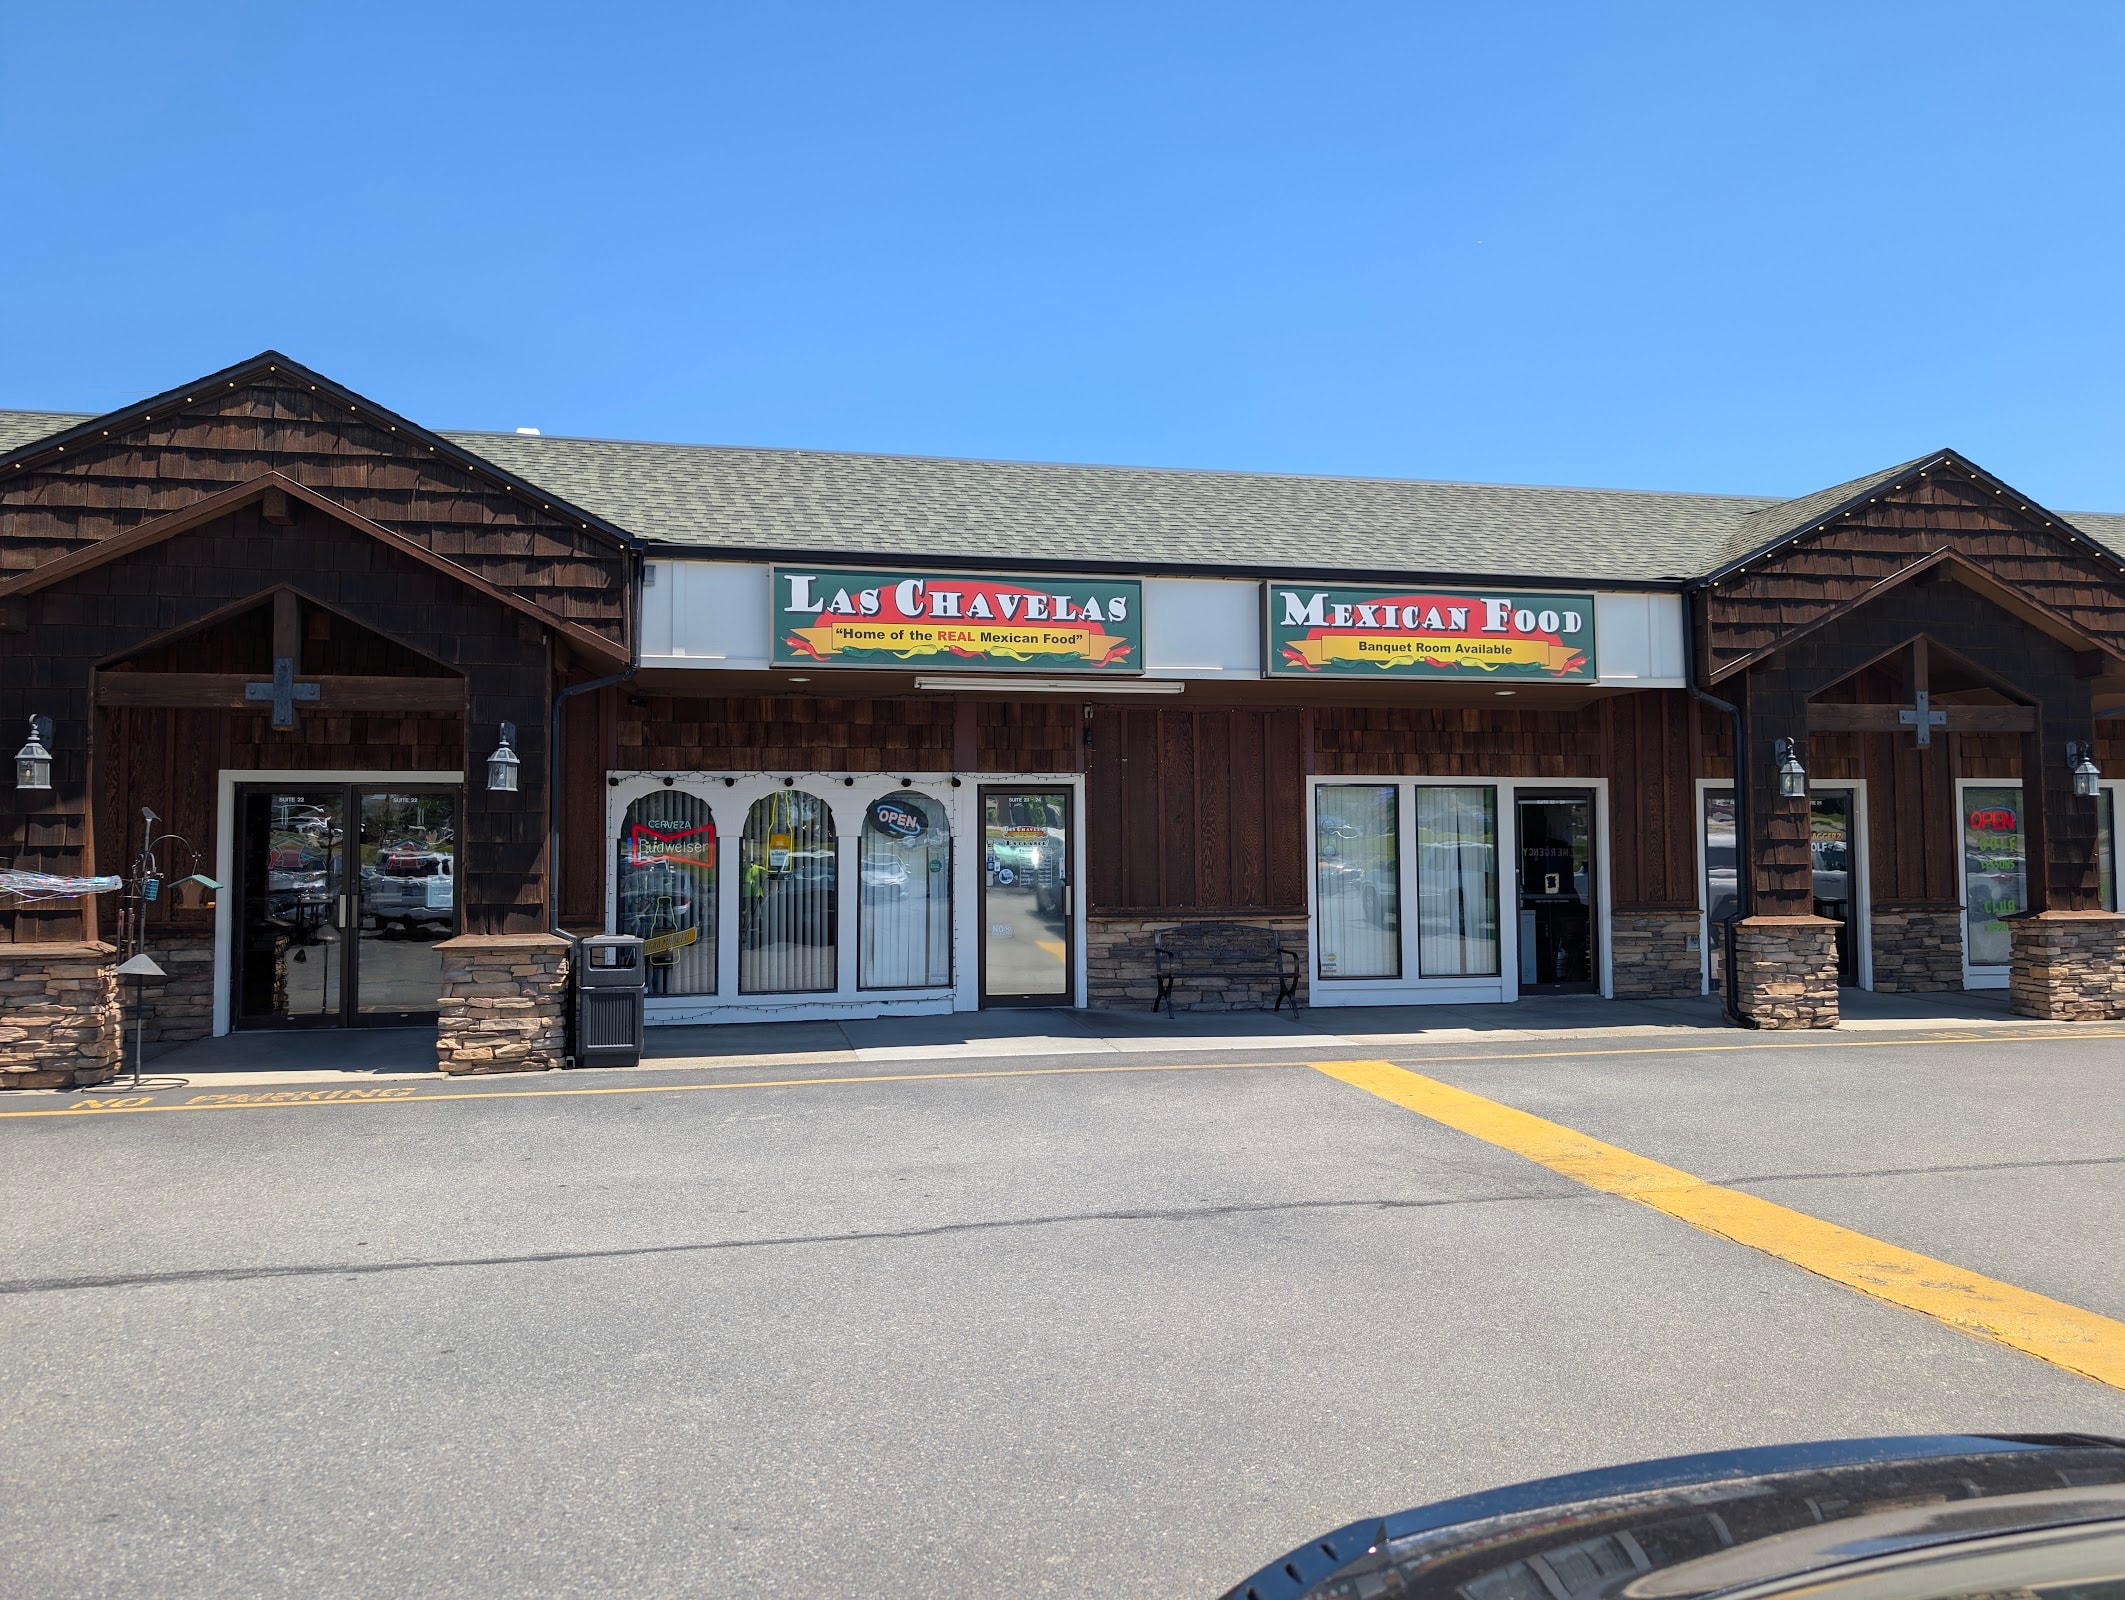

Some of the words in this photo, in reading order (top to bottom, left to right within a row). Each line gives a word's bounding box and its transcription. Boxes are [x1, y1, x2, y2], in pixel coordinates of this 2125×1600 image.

[783, 575, 881, 615] LAS
[895, 579, 1128, 622] CHAVELAS
[1279, 592, 1469, 631] MEXICAN
[1480, 597, 1583, 634] FOOD
[890, 629, 904, 642] of
[909, 630, 932, 642] the
[937, 631, 976, 642] REAL
[980, 632, 1038, 644] Mexican
[1358, 641, 1412, 654] Banquet
[1416, 642, 1451, 654] Room
[1456, 644, 1512, 655] Available
[648, 820, 691, 829] CERVEZA
[879, 810, 917, 828] OPEN
[1970, 810, 2015, 830] OPEN
[639, 838, 708, 854] Budweiser
[1981, 860, 2015, 870] LESSONS
[1984, 899, 2016, 914] CLUB
[68, 1096, 156, 1110] NO
[185, 1088, 416, 1105] PARKING
